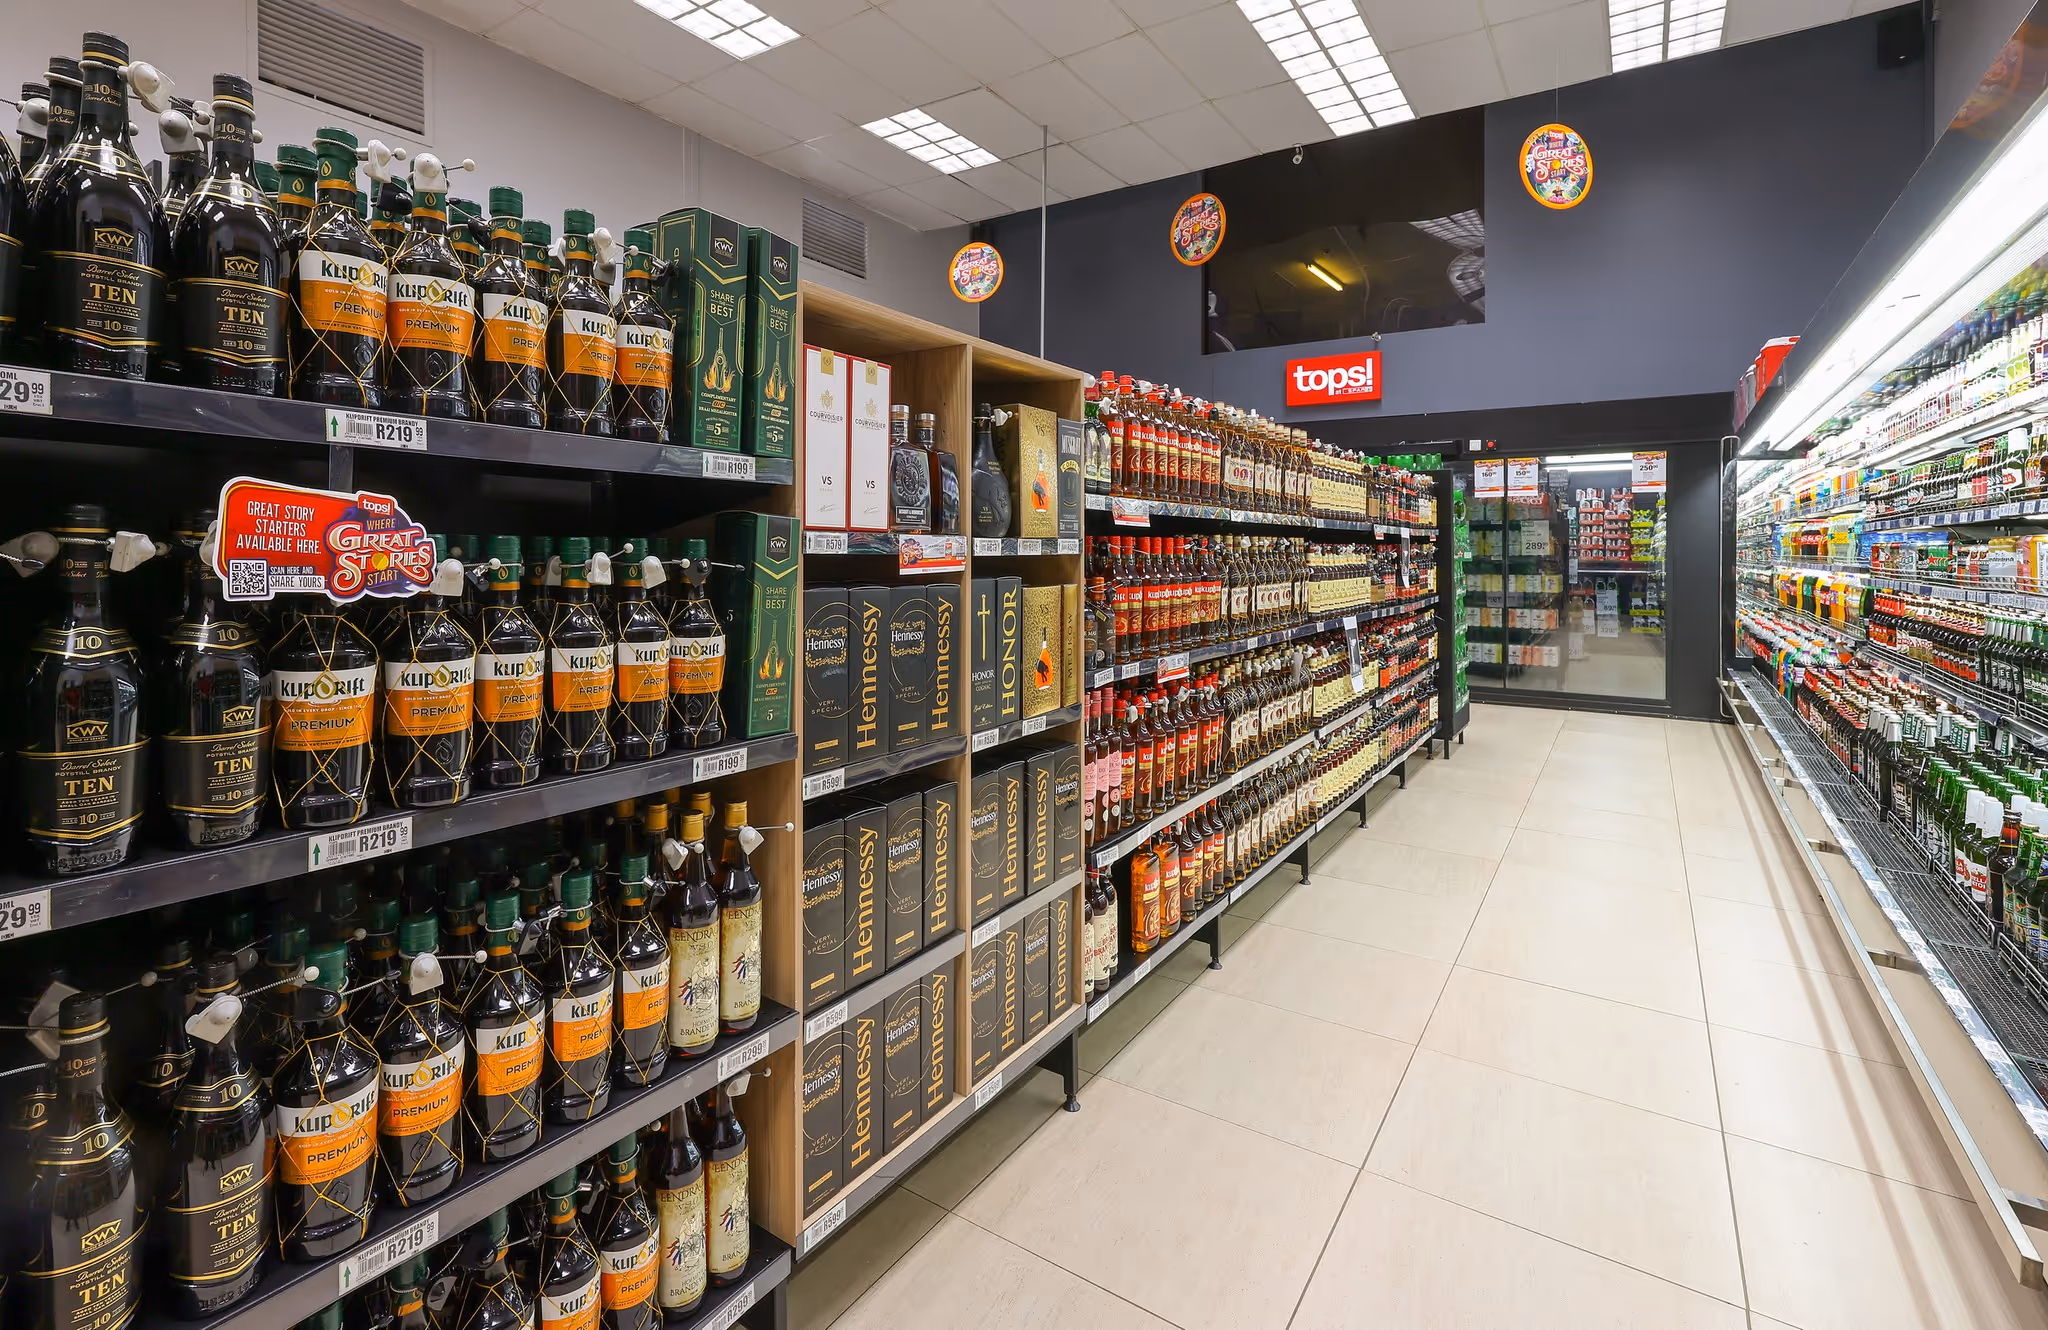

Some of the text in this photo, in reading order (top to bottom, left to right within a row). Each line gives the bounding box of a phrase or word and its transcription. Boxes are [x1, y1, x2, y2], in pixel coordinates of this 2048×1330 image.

[1533, 145, 1576, 159] GREAT
[1536, 156, 1584, 180] STORIES
[94, 230, 134, 247] KWV
[714, 240, 733, 253] KWV
[86, 264, 140, 280] Barrel Select
[224, 260, 259, 273] KWV
[773, 259, 788, 271] KWV
[81, 272, 144, 288] POTSTILL BRANDY
[90, 282, 137, 305] TEN
[710, 289, 734, 303] SHARE
[224, 306, 264, 325] TEN
[334, 302, 384, 320] PREMIUM
[710, 304, 733, 318] BEST
[770, 305, 788, 319] SHARE
[104, 320, 121, 331] 10
[406, 319, 460, 335] PREMIUM
[770, 319, 788, 333] BEST
[1293, 358, 1373, 396] tops!
[32, 383, 44, 394] 99
[346, 413, 418, 427] KLIPDRIFT PREMIUM BRANDY
[810, 410, 843, 422] COURVOISIER
[855, 418, 886, 429] COURVOISIER
[376, 423, 412, 442] R219
[714, 422, 722, 435] 5
[772, 431, 778, 442] 5
[728, 462, 748, 474] R199
[822, 476, 832, 486] VS
[866, 480, 876, 489] VS
[247, 501, 315, 522] GREAT STORY
[363, 499, 391, 515] tops!
[255, 520, 306, 536] STARTERS
[366, 518, 396, 531] WHERE
[236, 534, 322, 554] AVAILABLE HERE.
[328, 524, 420, 553] GREAT
[770, 540, 786, 549] KWV
[826, 538, 842, 550] R579
[270, 566, 313, 574] SCAN HERE AND
[335, 545, 431, 590] STORIES
[270, 576, 322, 588] SHARE YOURS
[367, 570, 398, 586] START
[766, 586, 787, 595] SHARE
[766, 599, 786, 609] BEST
[1039, 604, 1049, 615] VS
[75, 635, 102, 650] 10
[218, 628, 239, 641] 10
[892, 630, 924, 642] Hennessy
[806, 637, 846, 651] Hennessy
[1002, 584, 1017, 717] HONOR
[932, 596, 953, 730] Hennessy
[674, 671, 714, 680] PREMIUM
[857, 600, 882, 750] Hennessy
[972, 670, 994, 681] HONOR
[895, 691, 920, 699] SPECIAL
[975, 683, 991, 691] COGNAC
[223, 711, 254, 723] KWV
[412, 704, 466, 718] PREMIUM
[767, 709, 774, 720] 5
[811, 705, 841, 714] SPECIAL
[67, 725, 108, 738] KWV
[291, 717, 355, 730] PREMIUM
[60, 759, 118, 771] Barrel Select
[214, 756, 254, 775] TEN
[718, 759, 738, 772] R199
[64, 775, 114, 796] TEN
[822, 776, 839, 790] R599
[79, 813, 98, 824] 10
[1033, 768, 1049, 884] Hennessy
[329, 822, 403, 842] KLIPDRIFT PREMIUM BRANDY
[1004, 777, 1020, 897] Hennessy
[360, 830, 397, 852] R219
[889, 838, 920, 857] Hennessy
[931, 799, 951, 934] Hennessy
[802, 869, 841, 892] Hennessy
[29, 903, 40, 915] 99
[853, 826, 878, 976] Hennessy
[808, 938, 837, 955] SPECIAL
[814, 934, 830, 944] VERY
[1055, 900, 1068, 1010] Hennessy
[1002, 930, 1018, 1052] Hennessy
[886, 1018, 918, 1043] Hennessy
[928, 973, 947, 1109] Hennessy
[742, 1043, 763, 1063] R299
[219, 1083, 241, 1104] 10
[851, 1017, 875, 1168] Hennessy
[393, 1095, 449, 1118] PREMIUM
[82, 1133, 109, 1156] 10
[307, 1135, 368, 1164] PREMIUM
[220, 1166, 252, 1189] KWV
[218, 1208, 257, 1239] TEN
[82, 1222, 121, 1250] KWV
[358, 1243, 385, 1261] KLIPDRIFT
[386, 1230, 409, 1246] PREMIUM
[387, 1229, 423, 1262] R219
[229, 1248, 244, 1264] 10
[80, 1268, 126, 1305] TEN
[93, 1312, 111, 1329] 10
